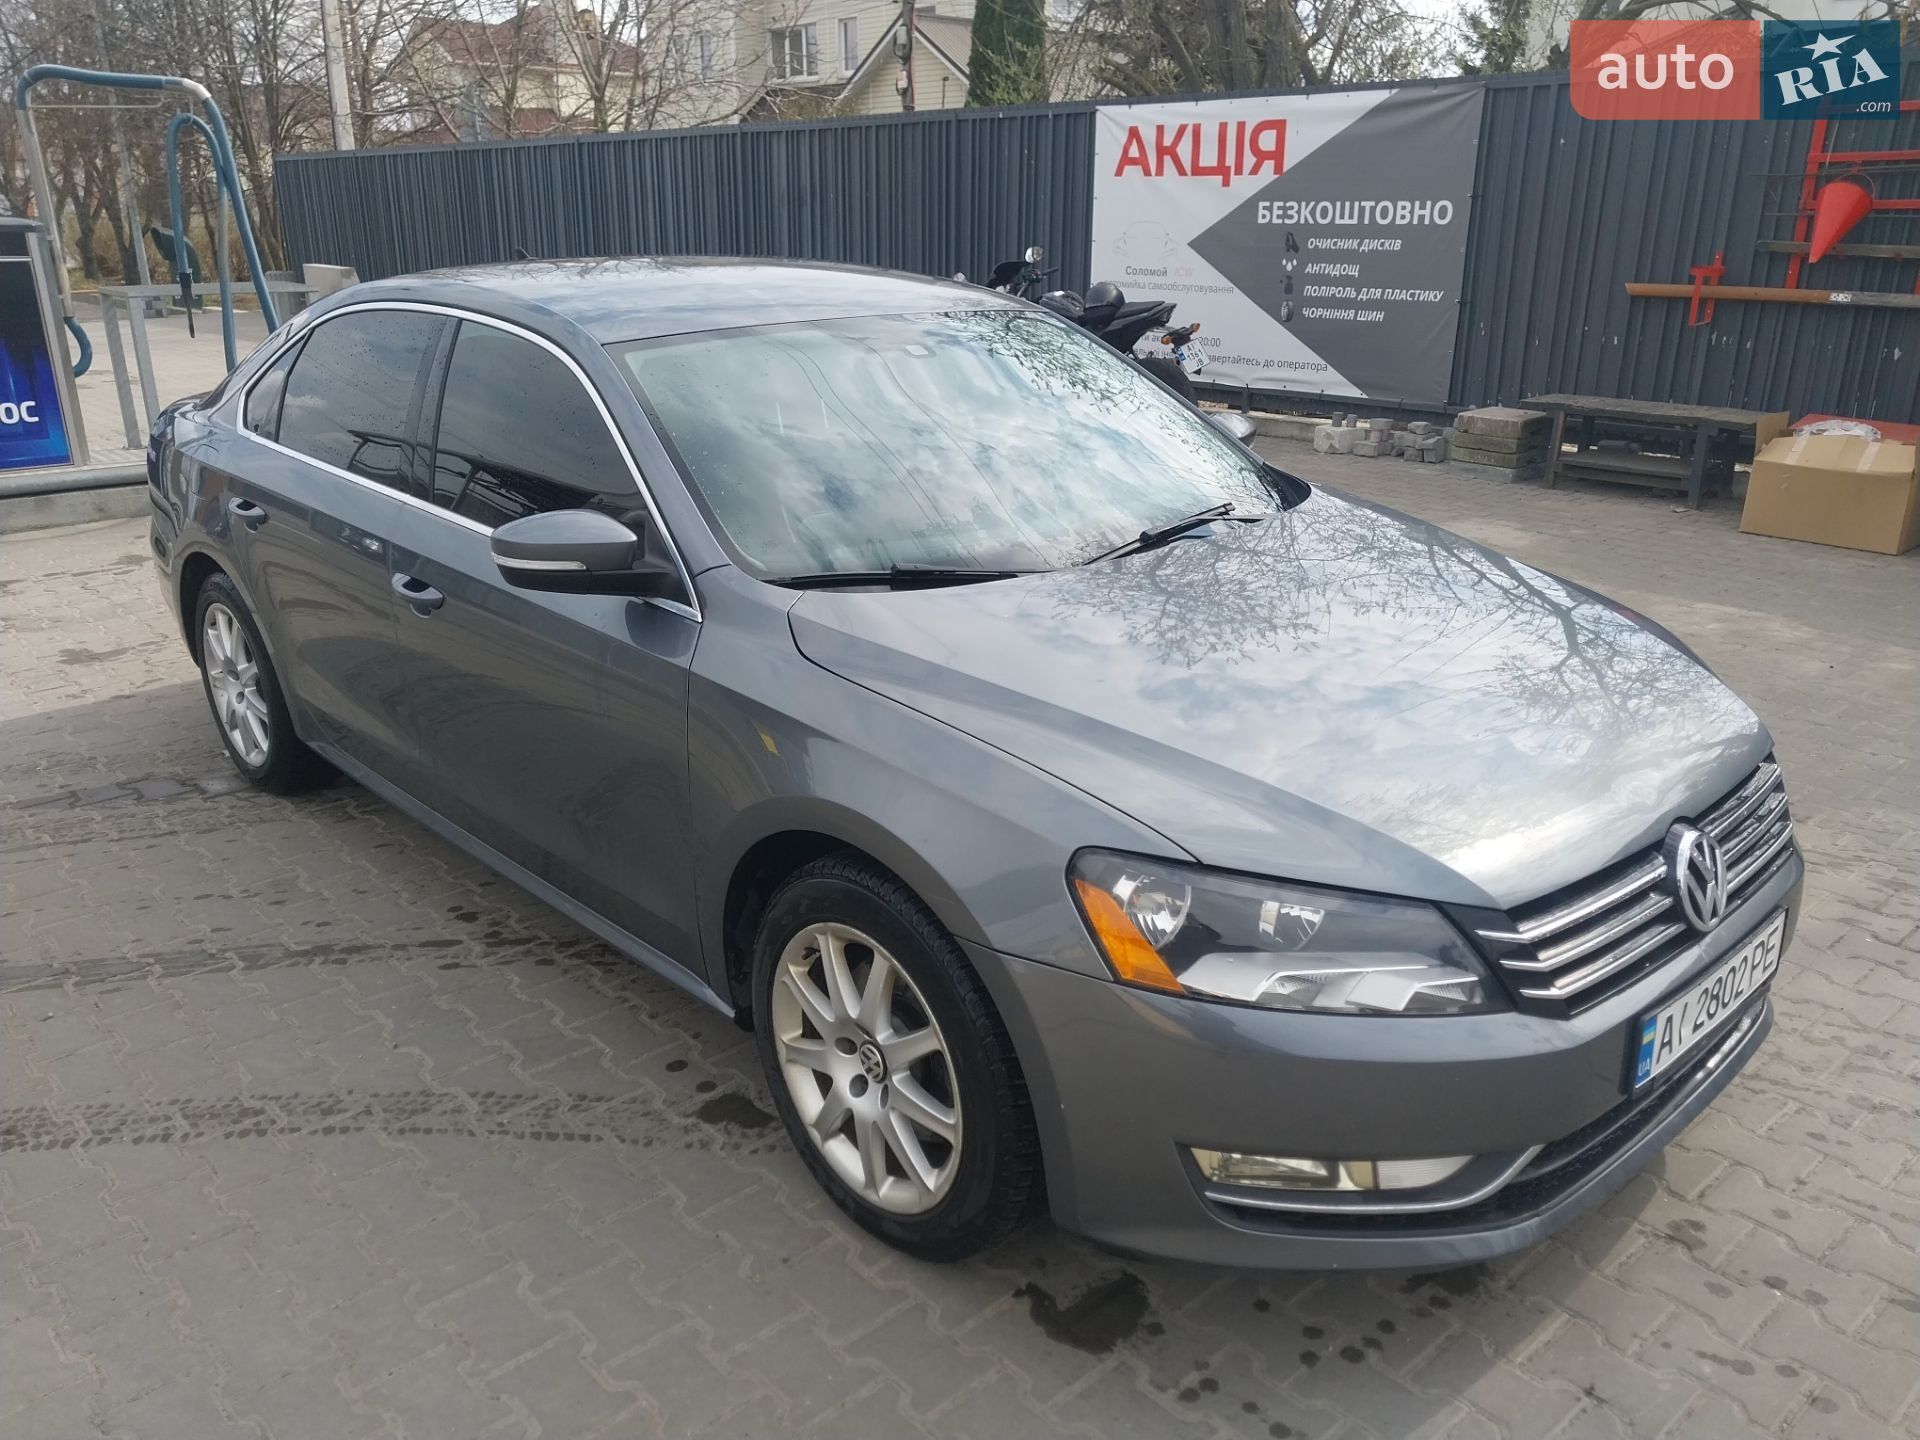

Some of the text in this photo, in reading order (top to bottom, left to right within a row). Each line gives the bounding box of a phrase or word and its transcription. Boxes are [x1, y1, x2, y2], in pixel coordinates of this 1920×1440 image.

[1114, 118, 1288, 188] АКЦІЯ
[1257, 200, 1454, 225] БЕЗКОШТОВНО
[1307, 238, 1402, 252] ОЧИСНИК ДИСКІВ
[1125, 265, 1168, 277] Соломой
[1304, 263, 1360, 278] АНТИДОЩ
[1147, 281, 1234, 296] самообслуговування
[1303, 285, 1445, 302] ПОЛІРОЛЬ ДЛЯ ПЛАСТИКУ
[1302, 307, 1385, 322] ЧОРНІННЯ ШИН
[1262, 359, 1275, 369] до
[1276, 360, 1328, 373] оператора
[1692, 954, 1749, 1034] 2802
[1750, 924, 1780, 987] PE
